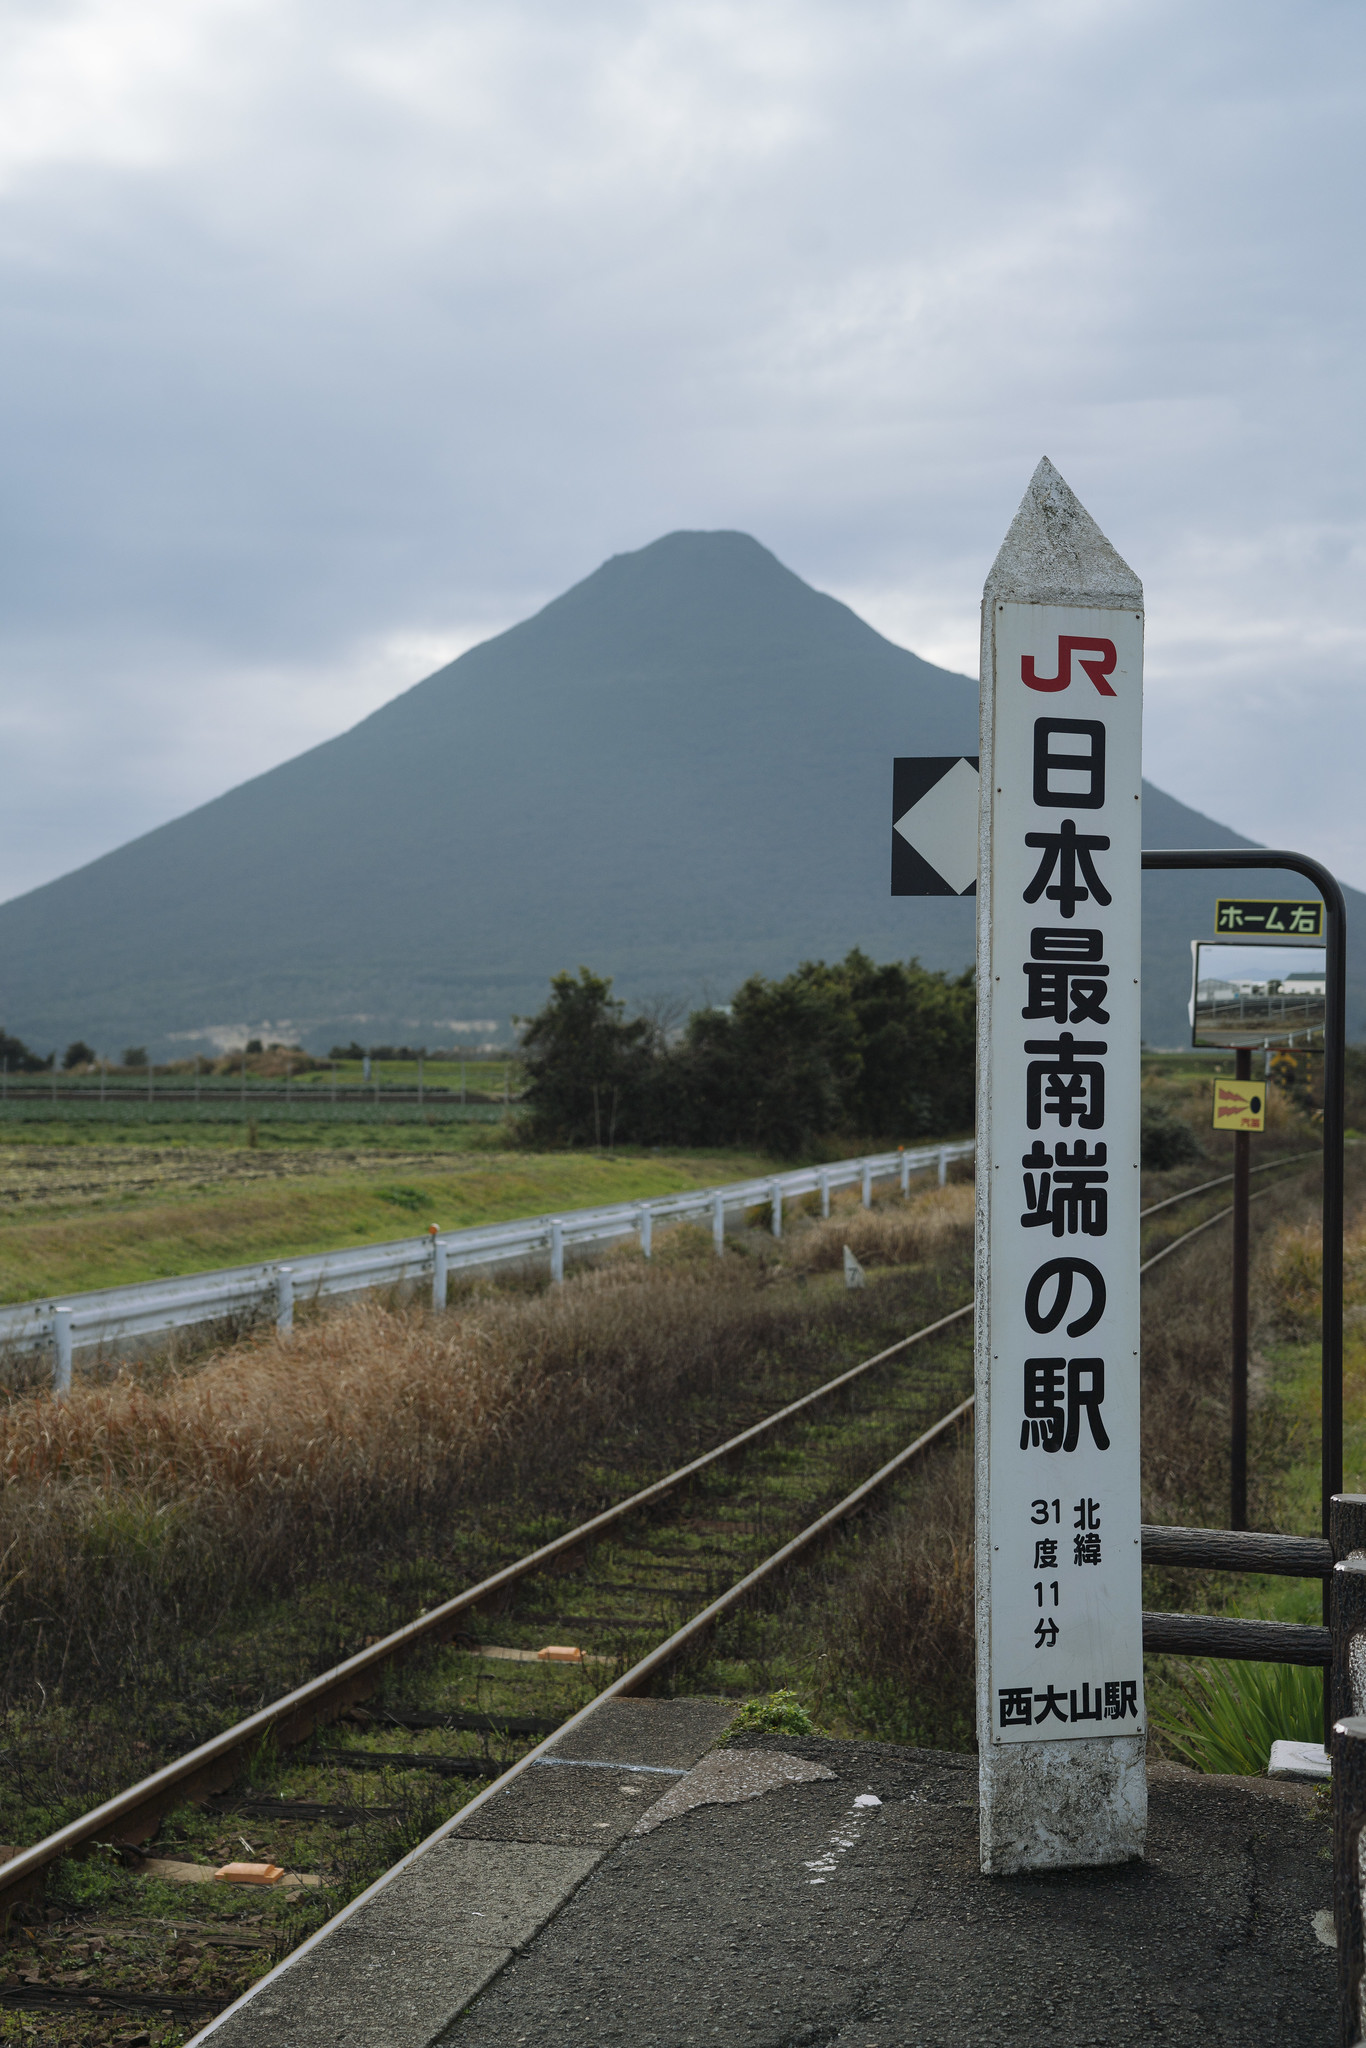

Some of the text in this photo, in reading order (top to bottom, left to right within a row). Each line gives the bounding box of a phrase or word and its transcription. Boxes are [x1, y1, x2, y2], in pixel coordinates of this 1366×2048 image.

[1021, 634, 1118, 697] JR
[1218, 905, 1317, 934] ホーム右
[1020, 716, 1113, 1453] 日本最南端の駅
[1073, 1497, 1102, 1567] 北緯
[998, 1680, 1139, 1728] 西大山駅
